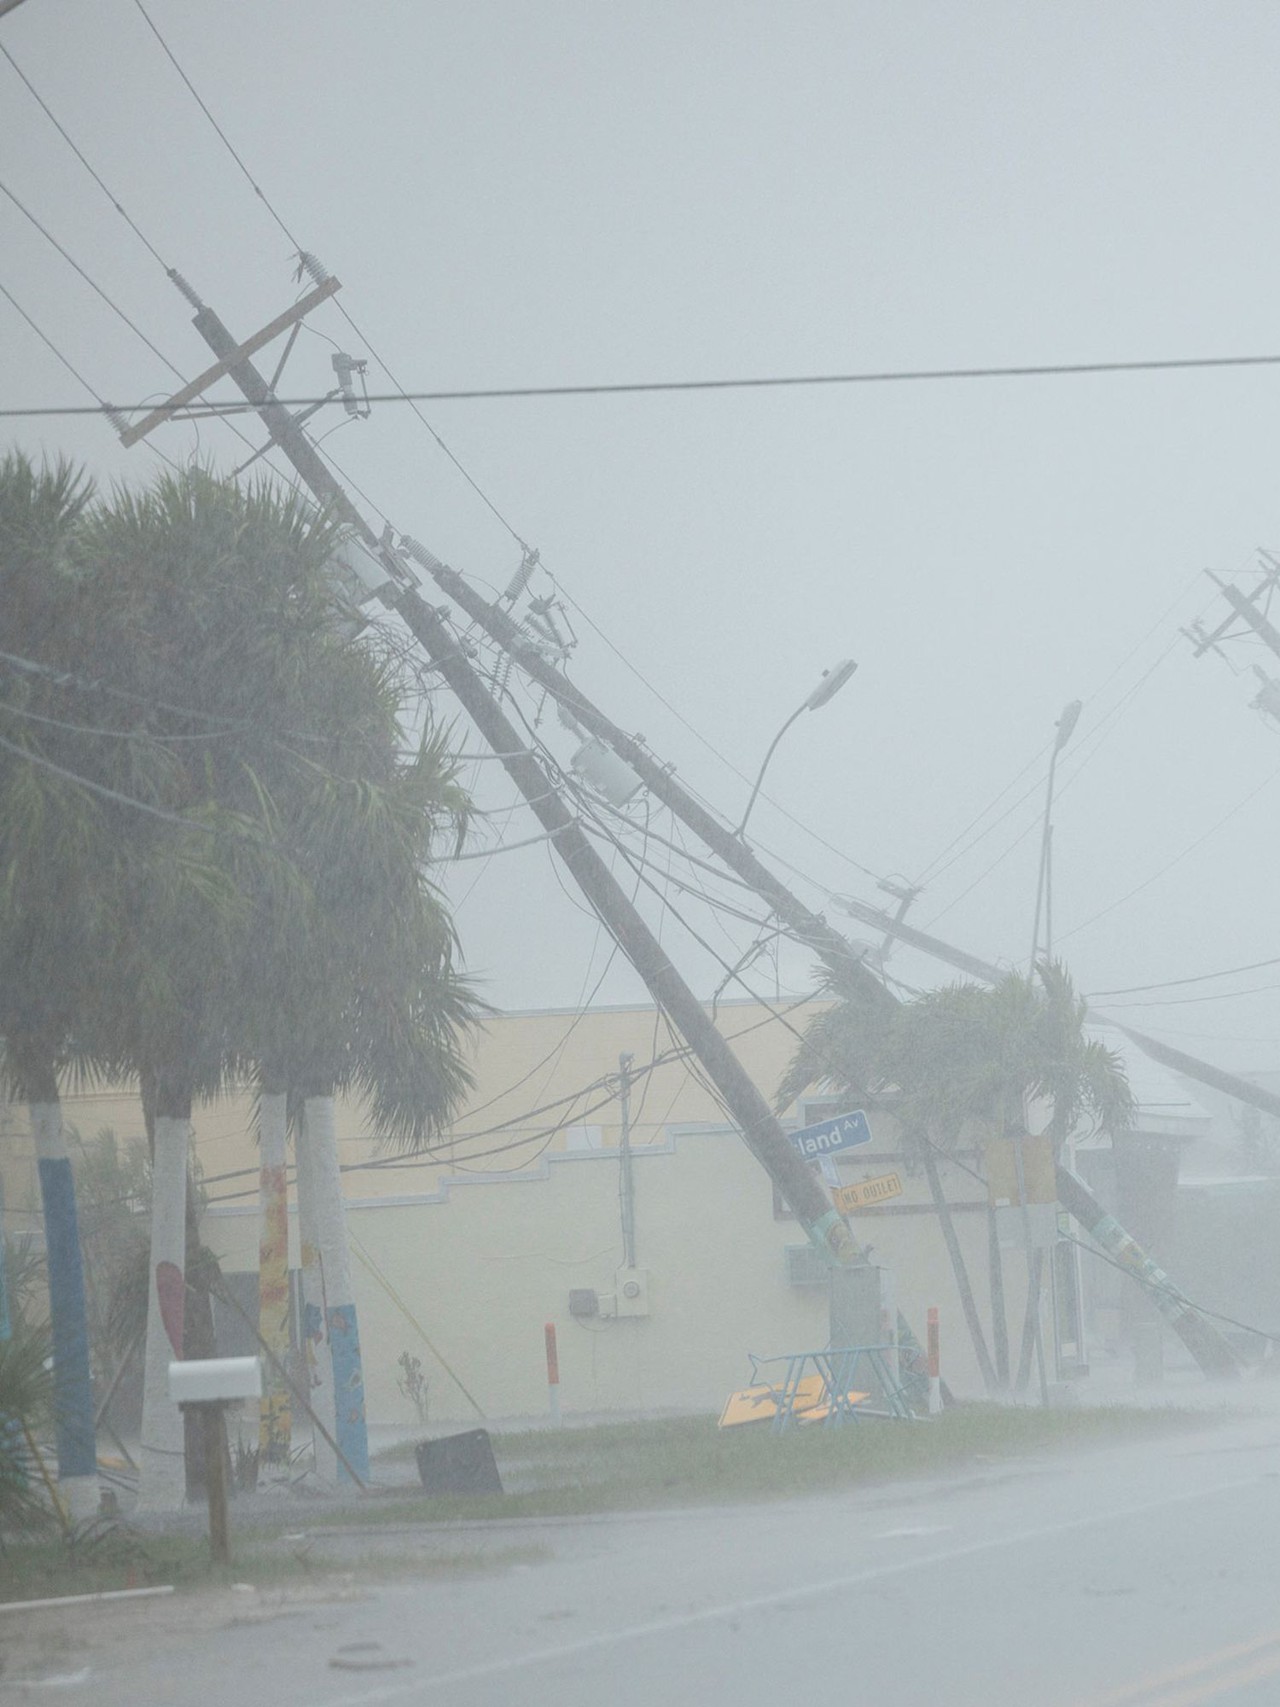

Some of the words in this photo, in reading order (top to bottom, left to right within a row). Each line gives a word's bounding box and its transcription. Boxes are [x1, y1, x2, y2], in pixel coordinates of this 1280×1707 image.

[795, 1126, 842, 1155] land
[844, 1119, 859, 1131] Av
[843, 1190, 859, 1203] NO
[862, 1178, 898, 1200] OUTLET
